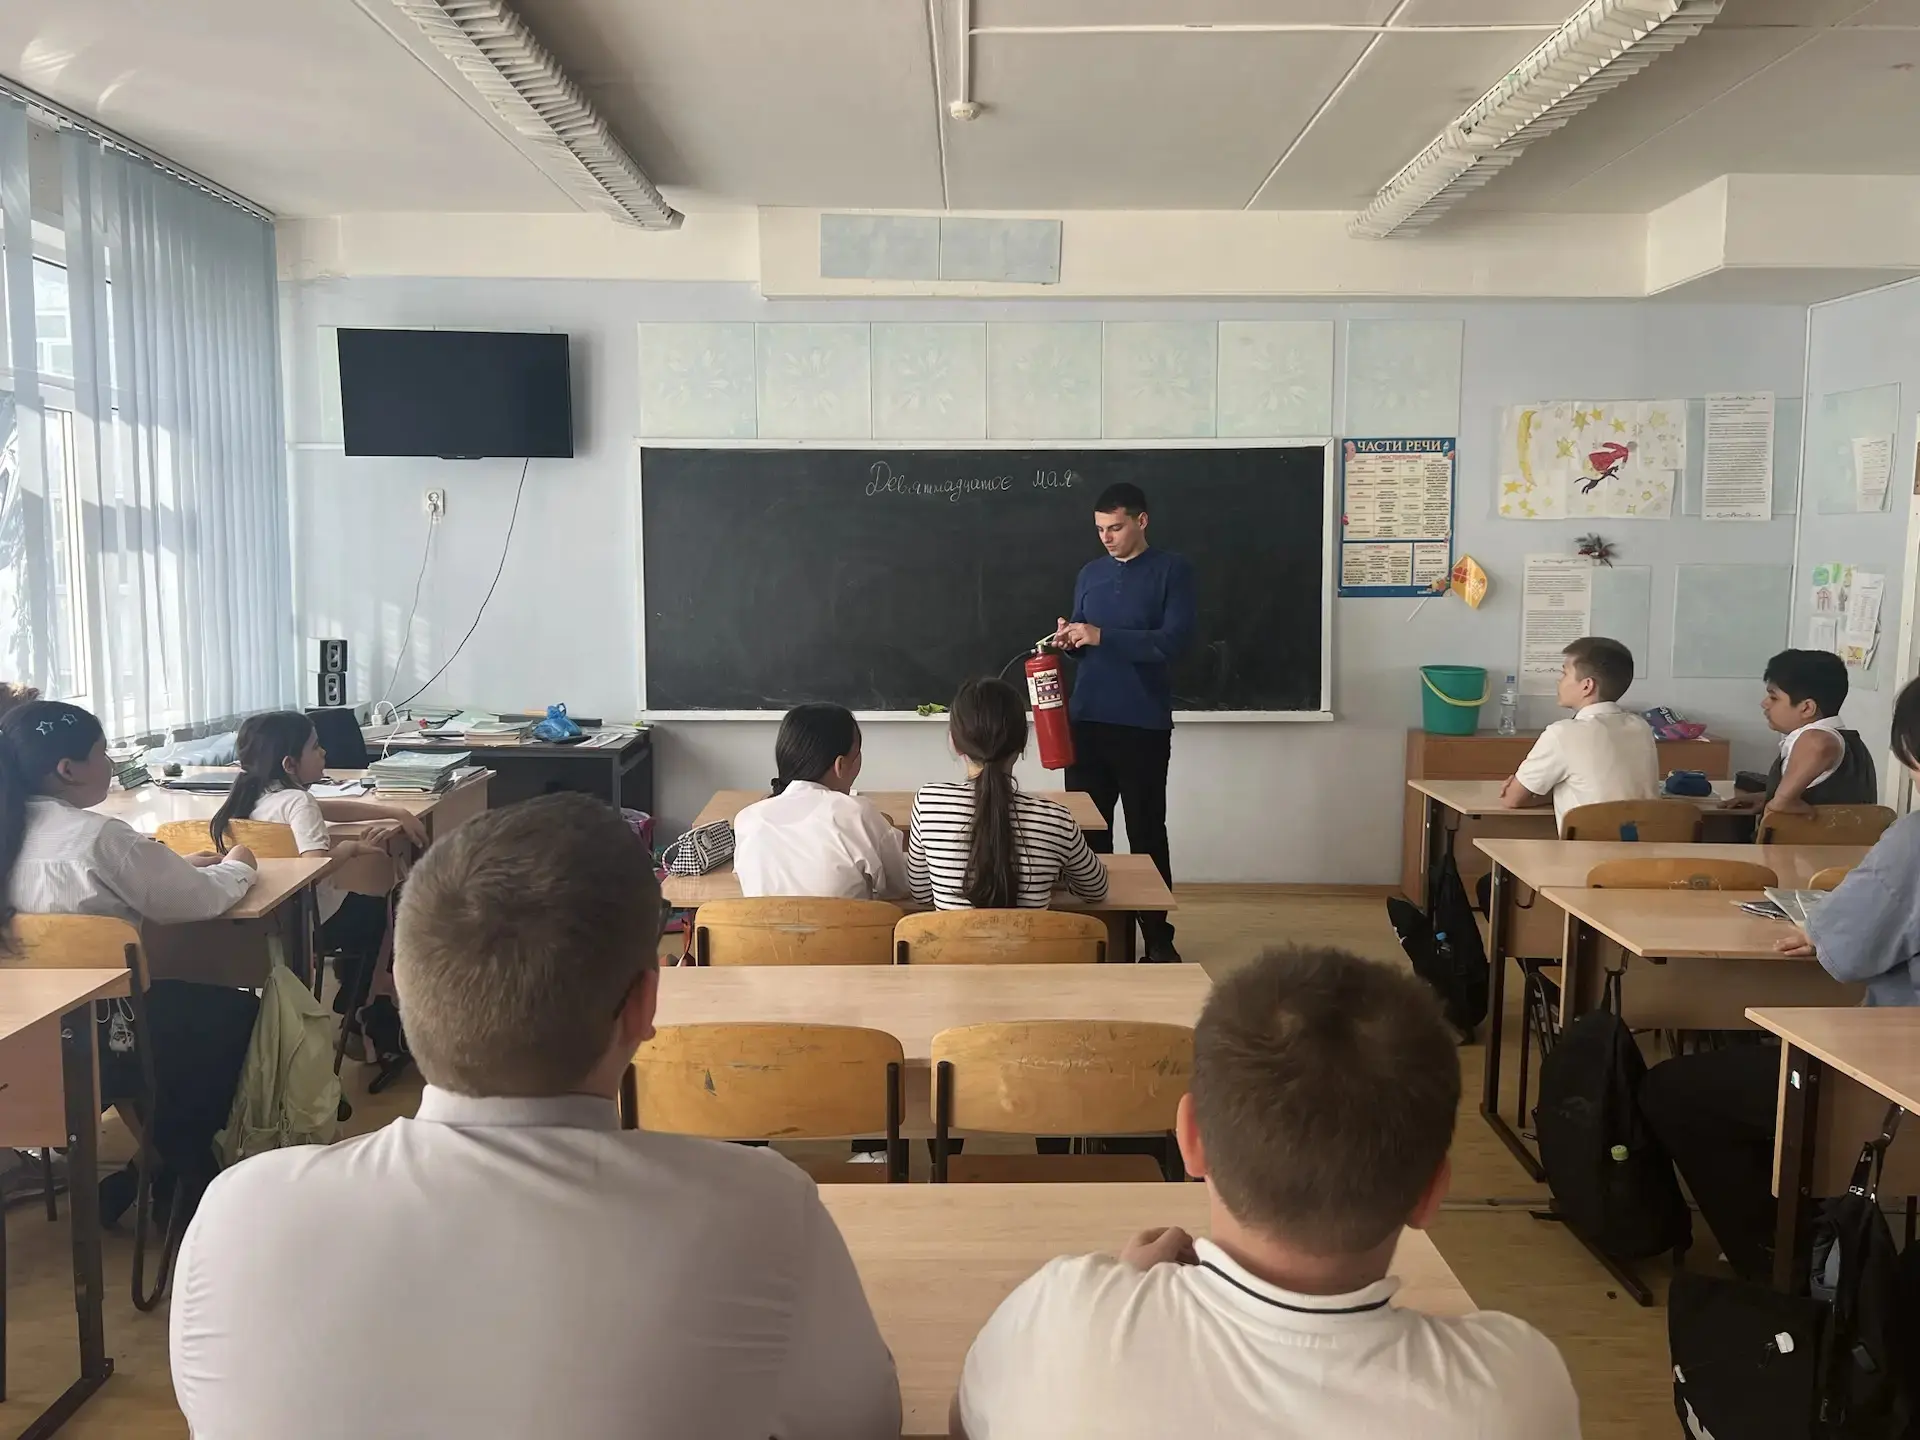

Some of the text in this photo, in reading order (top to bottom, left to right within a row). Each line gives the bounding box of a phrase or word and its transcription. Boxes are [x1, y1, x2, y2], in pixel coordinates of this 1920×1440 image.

[1357, 440, 1442, 451] ЧАСТИ РЕЧИ
[1032, 469, 1073, 489] мая
